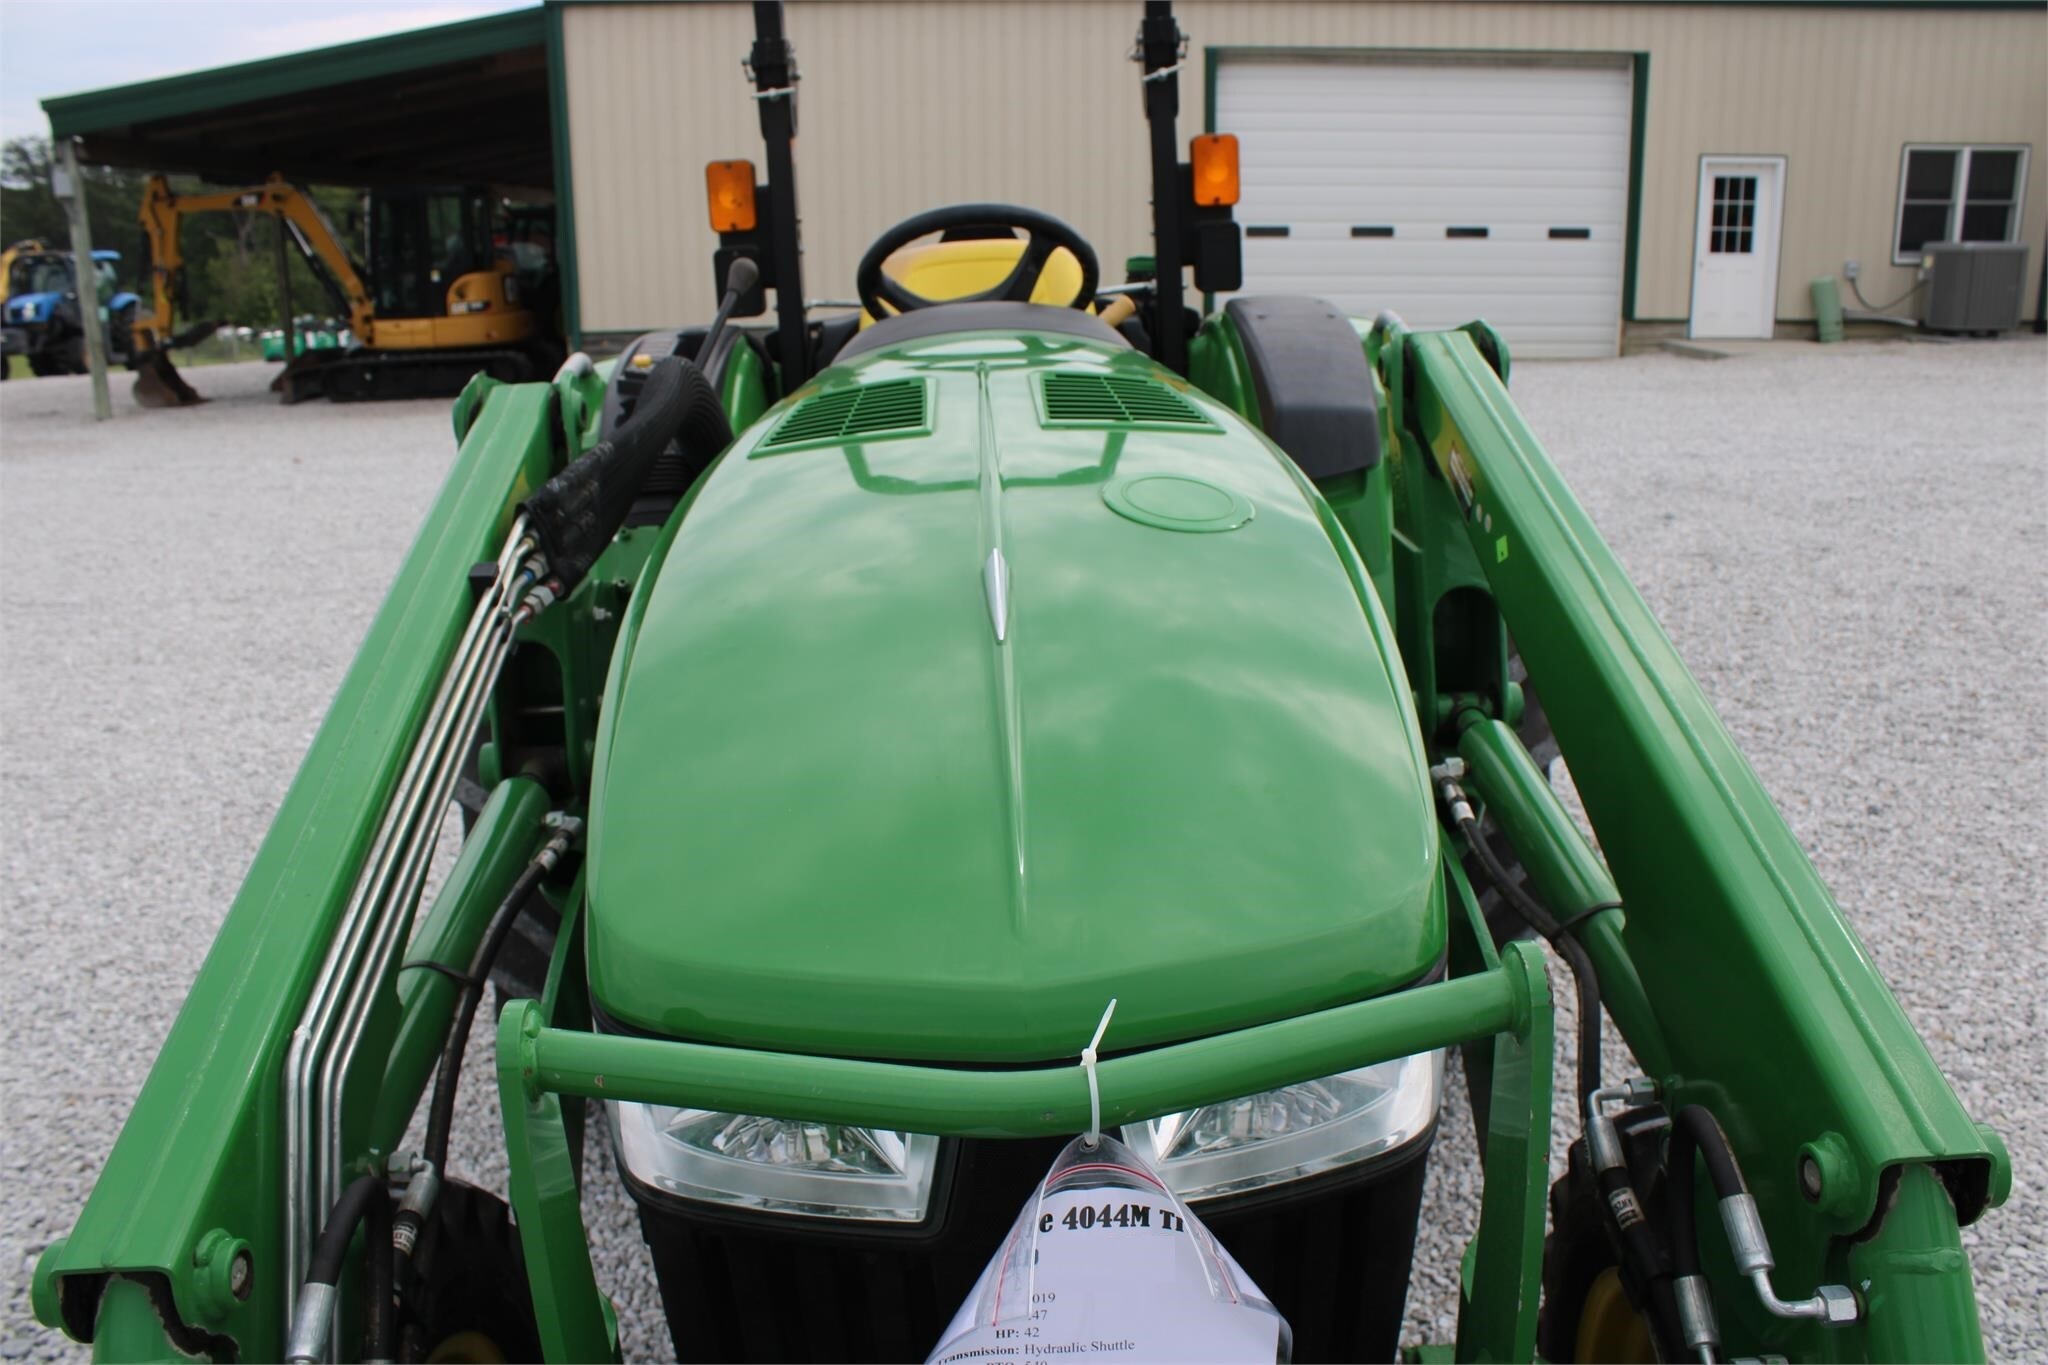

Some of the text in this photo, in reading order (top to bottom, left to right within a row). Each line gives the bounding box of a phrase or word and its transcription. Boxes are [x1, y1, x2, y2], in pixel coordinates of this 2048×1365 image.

[1062, 1204, 1151, 1230] 4044M
[995, 1327, 1040, 1339] HP: 42
[1024, 1342, 1087, 1357] Hydraulic
[1091, 1340, 1135, 1352] Shuttle
